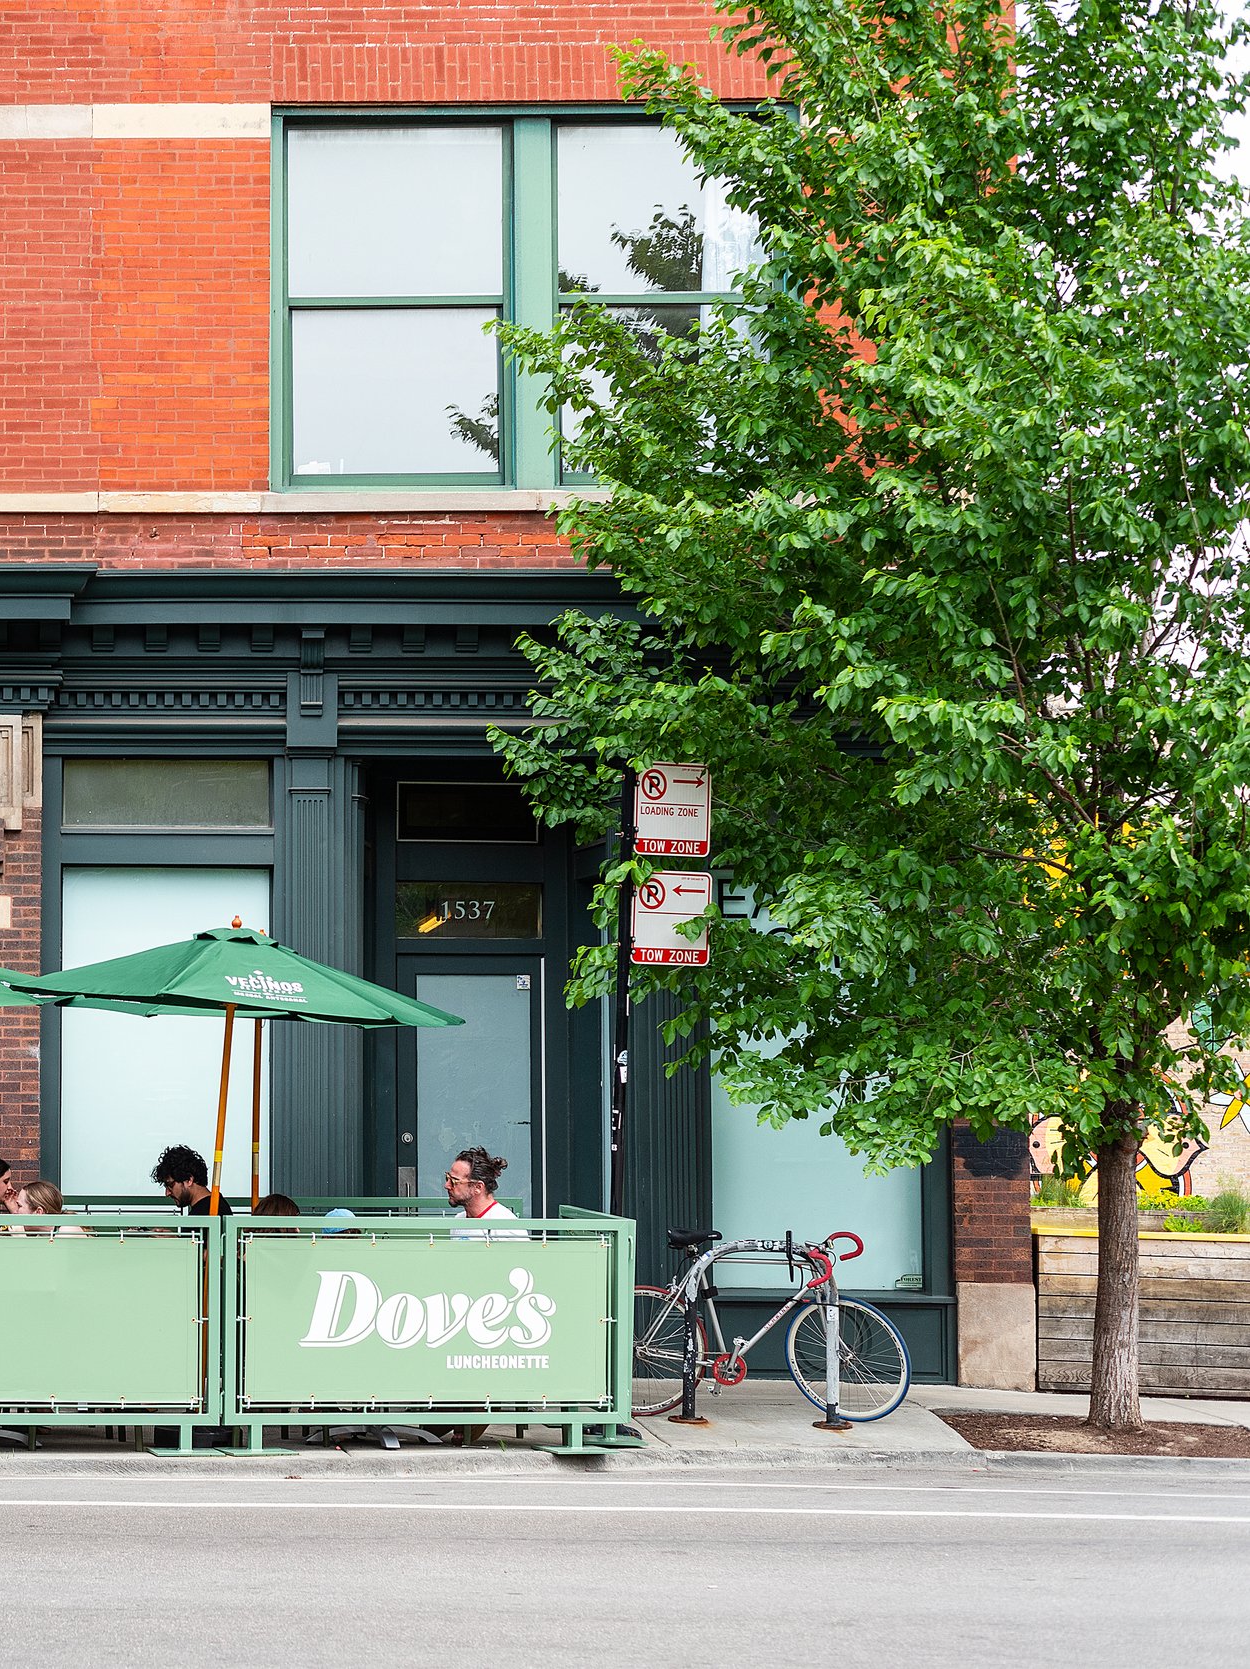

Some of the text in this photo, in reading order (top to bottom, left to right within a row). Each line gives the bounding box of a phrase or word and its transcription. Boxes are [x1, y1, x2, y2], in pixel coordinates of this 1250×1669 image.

[640, 806, 699, 817] LOADING ZONE
[643, 840, 700, 854] TOW ZONE
[441, 900, 496, 920] 1537
[640, 949, 700, 963] TOW ZONE
[298, 1266, 557, 1349] Dove's
[446, 1354, 550, 1370] LUNCHEONETTE
